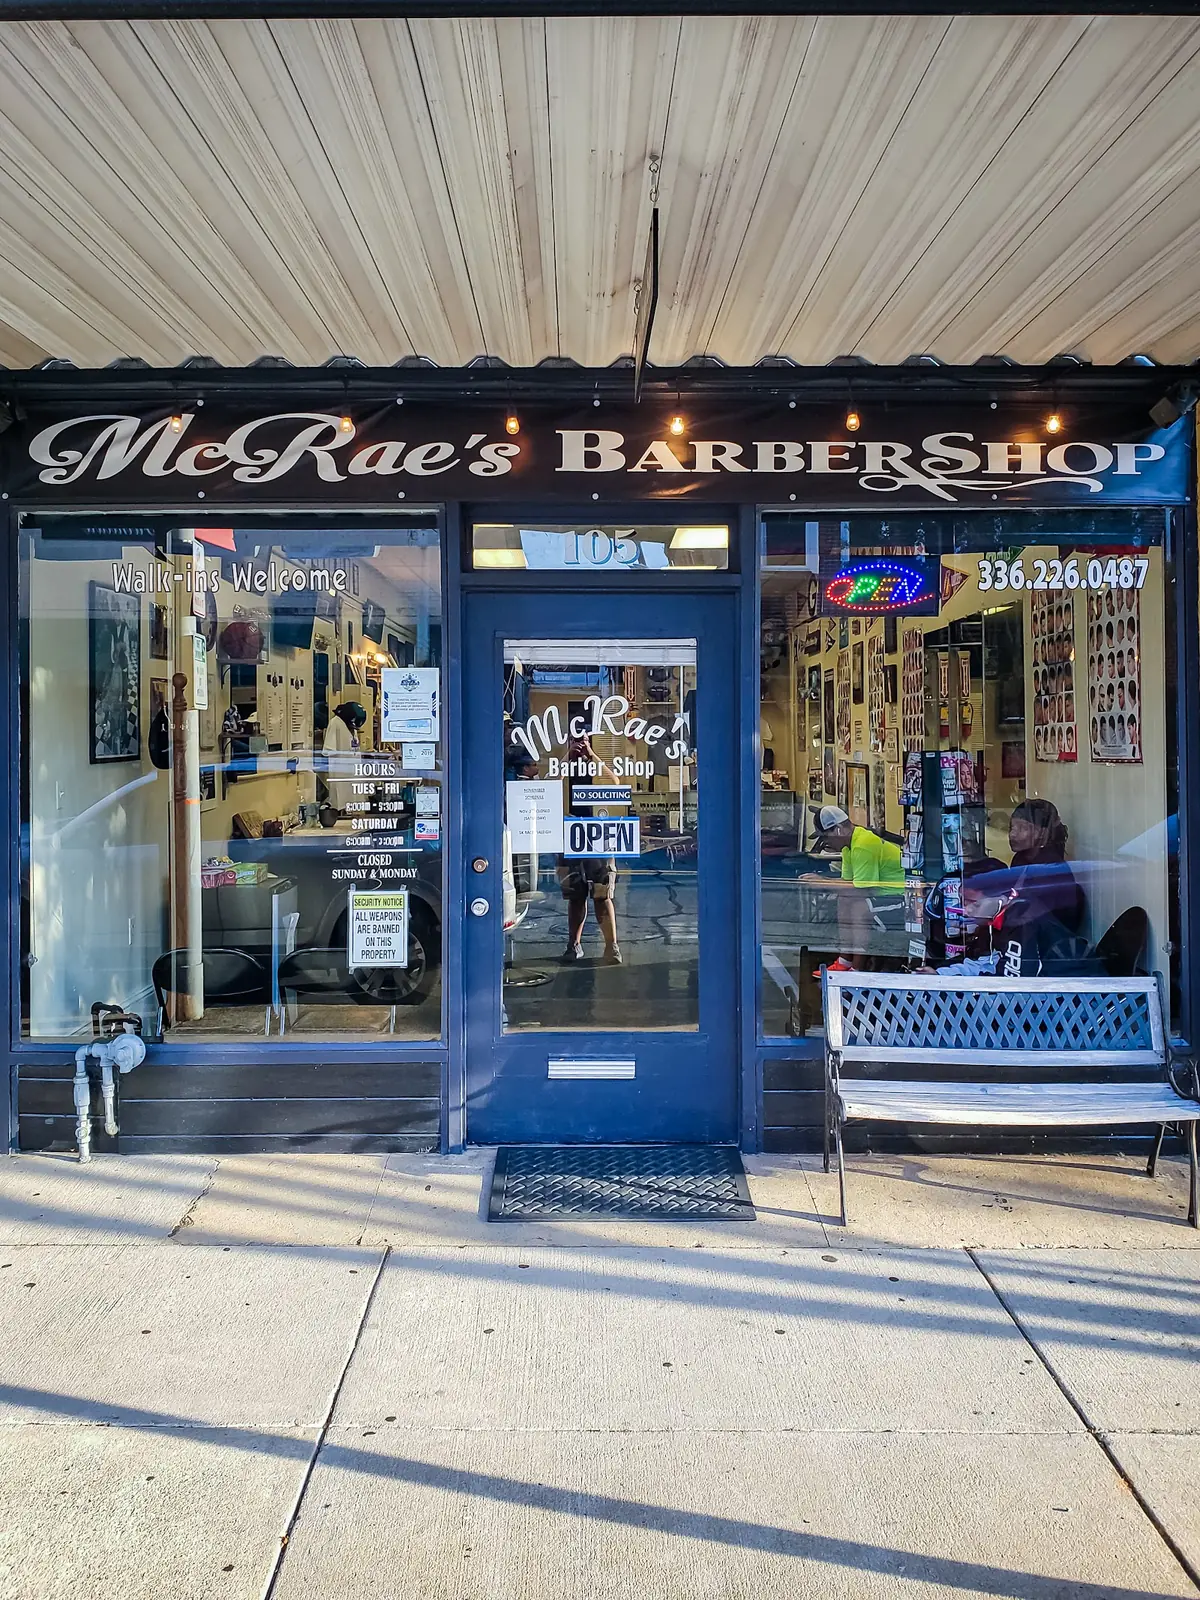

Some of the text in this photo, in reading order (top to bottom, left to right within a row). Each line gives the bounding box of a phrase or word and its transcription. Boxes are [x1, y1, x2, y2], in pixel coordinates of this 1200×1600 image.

[28, 412, 521, 484] McRae's
[563, 528, 642, 565] 105
[111, 561, 220, 593] Walk-ins
[232, 561, 348, 593] Welcome
[976, 558, 1149, 591] 336.226.0487
[825, 574, 924, 603] OPEN
[510, 694, 688, 762] McRae's
[353, 763, 396, 777] HOURS
[548, 756, 655, 780] Barber Shop
[351, 782, 375, 795] TUES
[384, 782, 400, 795] FRI
[572, 791, 631, 800] NO SOLICITING
[351, 817, 399, 830] SATURDAY
[345, 836, 371, 847] 6:00am
[569, 821, 635, 853] OPEN
[357, 854, 393, 866] CLOSED
[331, 868, 418, 880] SUNDAY & MONDAY
[354, 895, 403, 907] SECURITY NOTICE
[354, 911, 403, 922] ALL WEAPONS
[356, 924, 400, 934] ARE BANNED
[365, 937, 392, 947] ON THIS
[361, 949, 396, 960] PROPERTY
